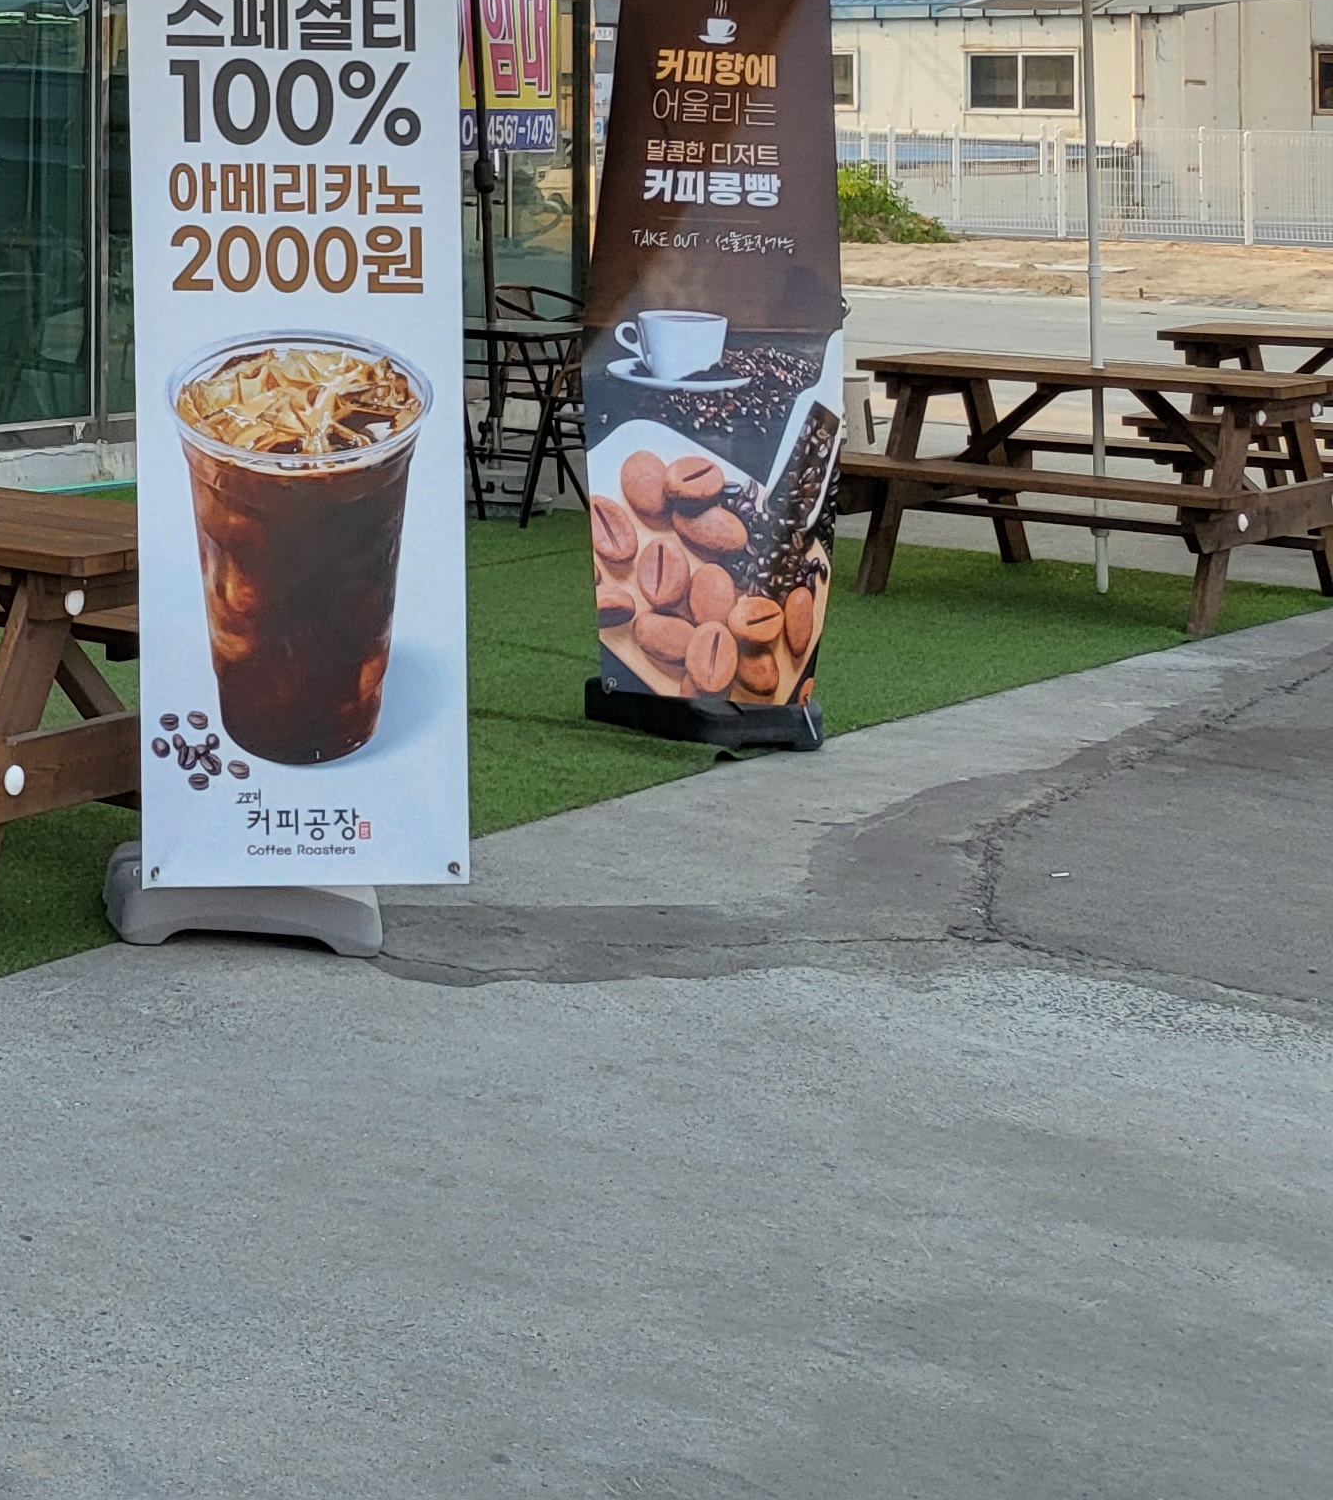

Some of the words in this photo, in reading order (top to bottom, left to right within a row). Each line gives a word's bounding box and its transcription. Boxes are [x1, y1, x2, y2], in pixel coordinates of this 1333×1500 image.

[655, 48, 777, 88] 커피향에
[169, 57, 422, 147] 100%
[651, 87, 778, 127] 어울리는
[646, 138, 706, 165] 달콤한
[711, 143, 781, 168] 디저트
[169, 162, 424, 216] 아메리카노
[643, 168, 782, 208] 커피콩빵
[632, 228, 669, 248] TAKE
[673, 231, 700, 249] OUT
[170, 224, 425, 295] 2000원
[235, 788, 261, 808] 고모리
[246, 808, 360, 841] 커피공장
[247, 844, 292, 856] Coffee
[297, 844, 356, 856] Roasters
